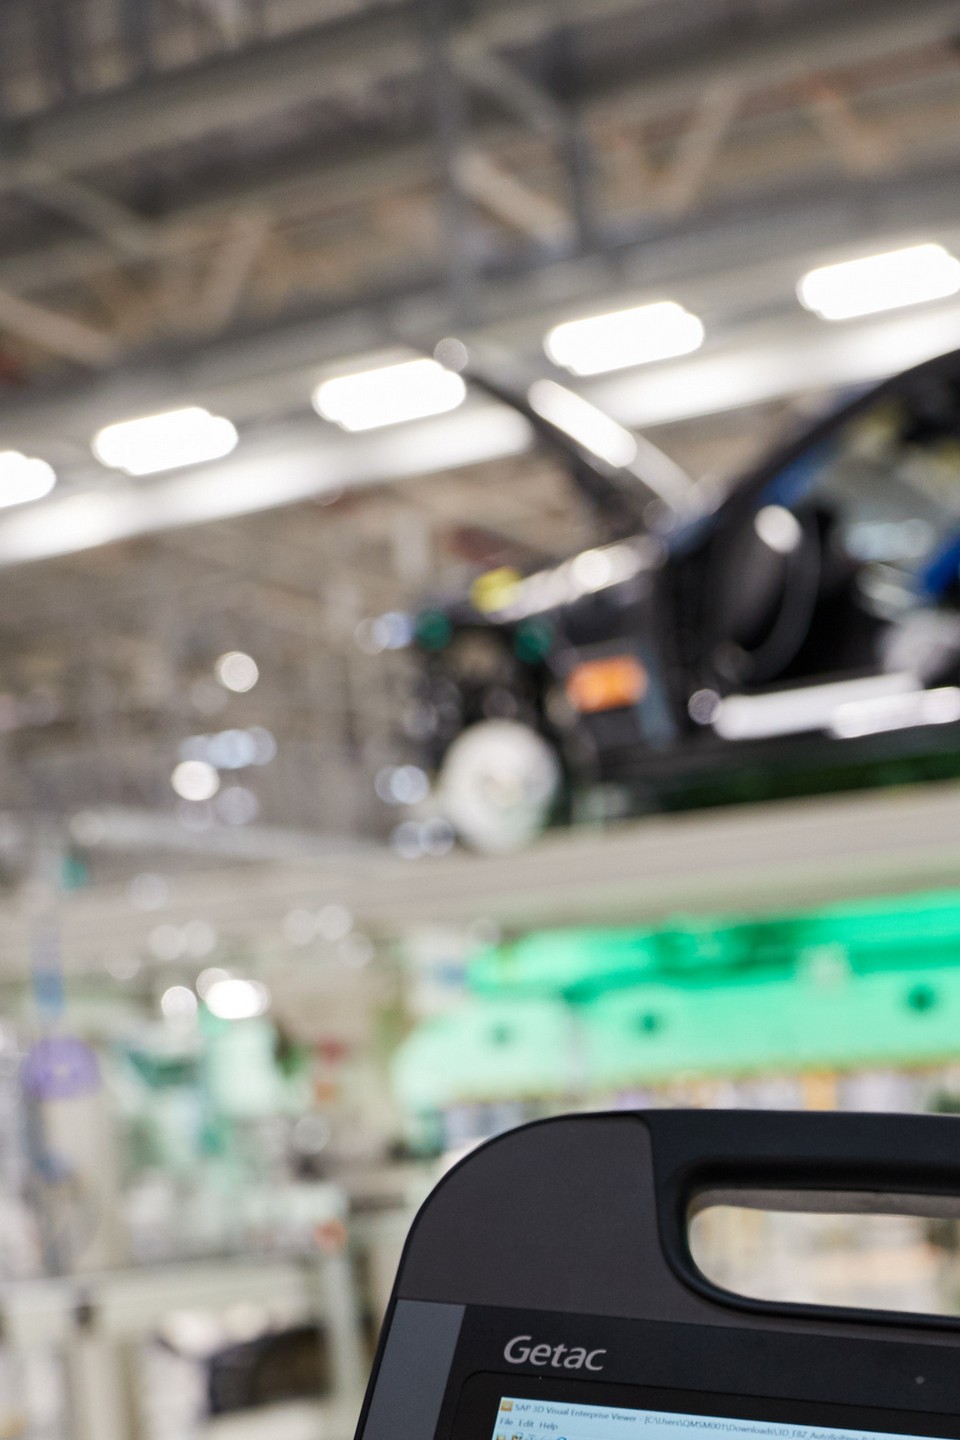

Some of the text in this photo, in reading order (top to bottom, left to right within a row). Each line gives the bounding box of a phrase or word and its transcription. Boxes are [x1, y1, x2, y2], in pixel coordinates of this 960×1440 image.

[503, 1335, 607, 1371] Getac
[515, 1403, 532, 1412] SAP
[534, 1405, 545, 1413] 3D
[546, 1406, 570, 1416] Visual
[570, 1409, 610, 1420] Enterprise
[611, 1413, 637, 1422] Viewer
[499, 1418, 559, 1431] File Edit Help
